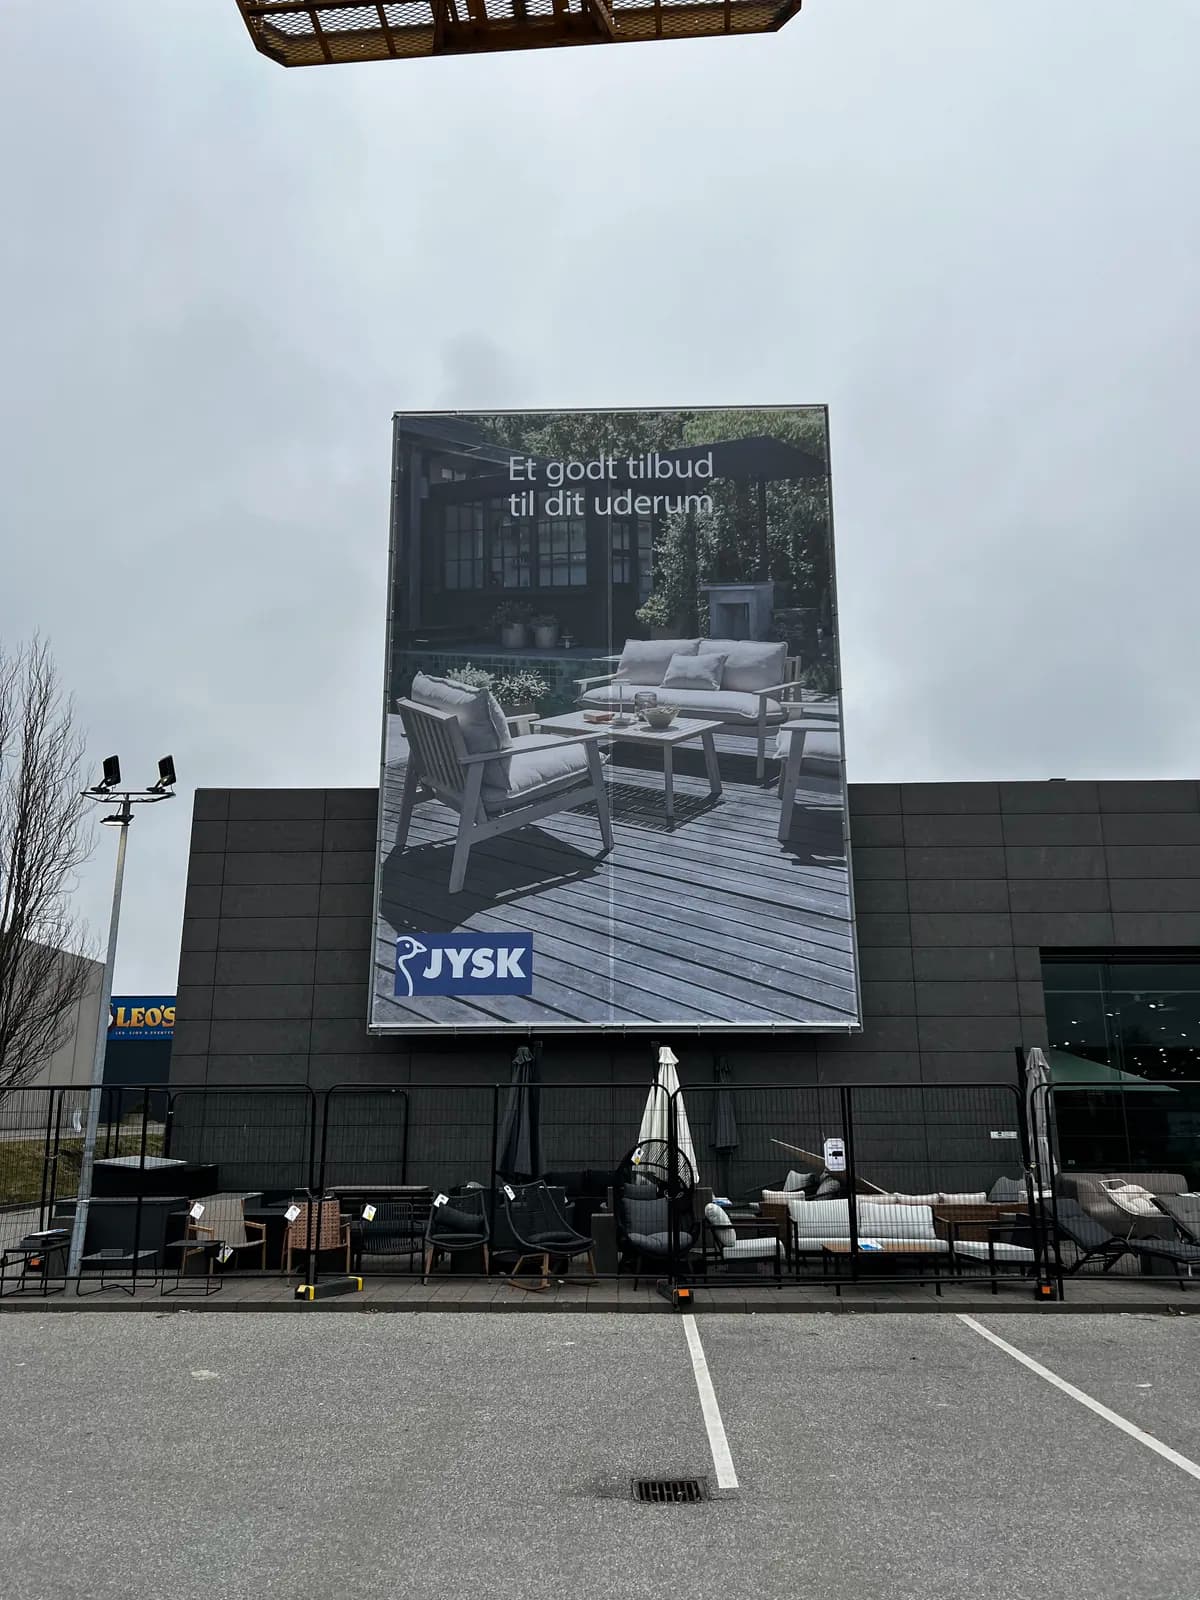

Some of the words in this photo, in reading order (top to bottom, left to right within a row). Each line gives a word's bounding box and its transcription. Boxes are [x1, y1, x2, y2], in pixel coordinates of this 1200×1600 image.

[509, 456, 537, 481] Et
[546, 454, 618, 487] godt
[626, 452, 713, 480] tilbud
[509, 490, 534, 517] til
[545, 490, 585, 516] dit
[594, 488, 713, 516] uderum
[422, 948, 527, 979] JYSK
[116, 1005, 176, 1028] LEO'S
